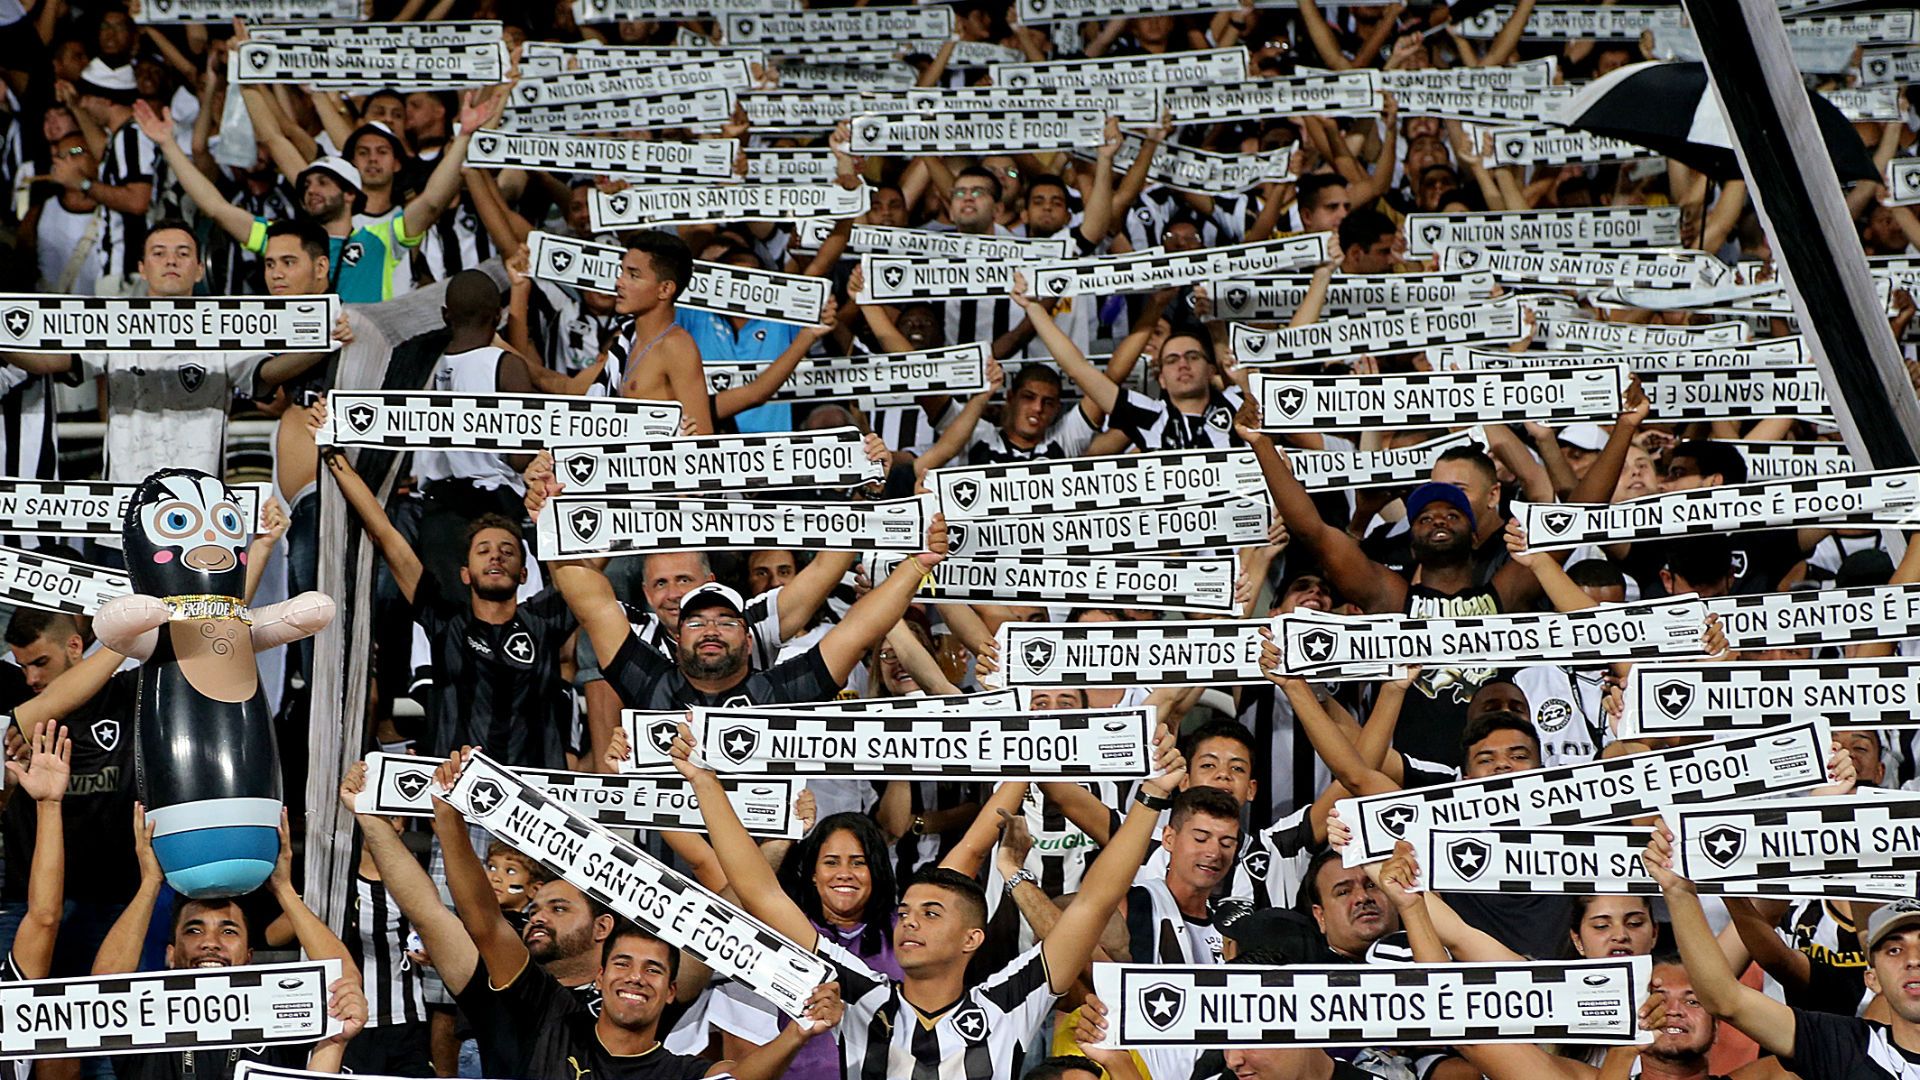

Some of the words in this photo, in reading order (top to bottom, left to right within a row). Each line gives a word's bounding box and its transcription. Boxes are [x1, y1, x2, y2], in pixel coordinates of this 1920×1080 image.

[889, 124, 939, 141] NILTON
[944, 122, 1004, 140] SANTOS
[1023, 121, 1067, 138] FOGO!
[507, 138, 559, 157] NILTON
[565, 140, 625, 160] SANTOS
[646, 144, 691, 163] FOGO!
[1534, 137, 1583, 154] NILTON
[778, 161, 821, 175] FOGO!
[639, 191, 690, 210] NILTON
[697, 188, 759, 207] SANTOS
[779, 188, 825, 206] FOGO!
[1452, 225, 1504, 242] NILTON
[1511, 222, 1572, 240] SANTOS
[1594, 219, 1640, 237] FOGO!
[852, 230, 891, 247] ILTON
[898, 235, 957, 252] SANTOS
[978, 242, 1024, 259] FOGO!
[914, 266, 969, 285] NILTON
[975, 264, 1019, 283] SANT
[1079, 273, 1135, 289] NILTON
[1141, 264, 1206, 282] SANTOS
[1229, 255, 1278, 272] FOGO!
[1488, 253, 1543, 272] NILTON
[1549, 257, 1614, 275] SANTOS
[1636, 263, 1686, 277] FOGO!
[581, 257, 622, 278] NILT
[730, 281, 779, 305] FOGO!
[1406, 285, 1455, 302] FOGO!
[43, 312, 108, 334] NILTON
[116, 313, 193, 334] SANTOS
[201, 307, 212, 334] É
[220, 313, 277, 334] FOGO!
[1276, 326, 1331, 348] NILTON
[1338, 317, 1404, 342] SANTOS
[1427, 311, 1476, 332] FOGO!
[1556, 320, 1621, 342] SANTOS
[1644, 330, 1694, 347] FOGO!
[803, 366, 867, 385] SANTOS
[890, 361, 938, 379] FOGO!
[1317, 389, 1384, 412] NILTON
[1393, 387, 1474, 410] SANTOS
[1503, 383, 1564, 405] FOGO!
[1684, 382, 1764, 403] SANTOS
[1773, 380, 1826, 401] ILTON
[387, 409, 454, 432] NILTON
[463, 411, 541, 434] SANTOS
[550, 409, 560, 436] É
[569, 415, 627, 437] FOGO!
[608, 454, 675, 478] NILTON
[684, 450, 764, 475] SANTOS
[773, 442, 784, 471] É
[792, 446, 851, 470] FOGO!
[1290, 452, 1345, 476] NTOS
[1371, 450, 1427, 468] FOGO!
[1752, 457, 1817, 477] NILTON
[990, 478, 1054, 503] NILTON
[1061, 471, 1137, 497] SANTOS
[1145, 465, 1156, 491] É
[1164, 466, 1220, 490] FOGO!
[24, 498, 108, 517] SANTOS
[613, 511, 683, 533] NILTON
[692, 511, 775, 532] SANTOS
[783, 507, 795, 532] É
[803, 512, 865, 532] FOGO!
[1587, 505, 1662, 531] NILTON
[1672, 499, 1763, 522] SANTOS
[978, 521, 1044, 547] NILTON
[1052, 515, 1131, 542] SANTOS
[1139, 508, 1150, 536] É
[1158, 509, 1216, 534] FOGO!
[14, 565, 81, 599] FOGO!
[1004, 567, 1087, 588] SANTOS
[1096, 566, 1107, 589] É
[1116, 571, 1176, 591] FOGO!
[182, 602, 230, 617] EXPLODE
[1777, 601, 1873, 629] SANTOS
[1884, 594, 1896, 620] É
[1066, 644, 1139, 667] NILTON
[1148, 642, 1235, 665] SANTOS
[1244, 637, 1256, 663] É
[1350, 632, 1432, 661] NILTON
[1441, 628, 1539, 655] SANTOS
[1549, 620, 1564, 648] É
[1572, 620, 1646, 646] FOGO!
[1708, 686, 1793, 709] NILTON
[1803, 683, 1906, 706] SANTOS
[771, 735, 856, 758] NILTON
[867, 737, 967, 759] SANTOS
[978, 730, 992, 760] É
[1003, 735, 1077, 761] FOGO!
[69, 767, 119, 794] VITON
[1431, 791, 1520, 825] NILTON
[1530, 773, 1633, 809] SANTOS
[1645, 763, 1660, 792] É
[1670, 752, 1751, 788] FOGO!
[546, 786, 623, 804] ANTOS
[633, 786, 645, 806] É
[1761, 827, 1859, 858] NILTON
[1505, 850, 1599, 876] NILTON
[505, 804, 583, 867] NILTON
[583, 852, 672, 920] SANTOS
[672, 901, 695, 933] É
[692, 917, 763, 974] FOGO!
[16, 998, 128, 1033] SANTOS
[139, 989, 154, 1026] É
[167, 993, 249, 1025] FOGO!
[1200, 992, 1296, 1024] NILTON
[1310, 992, 1425, 1022] SANTOS
[1438, 983, 1453, 1020] É
[1466, 989, 1552, 1019] FOGO!
